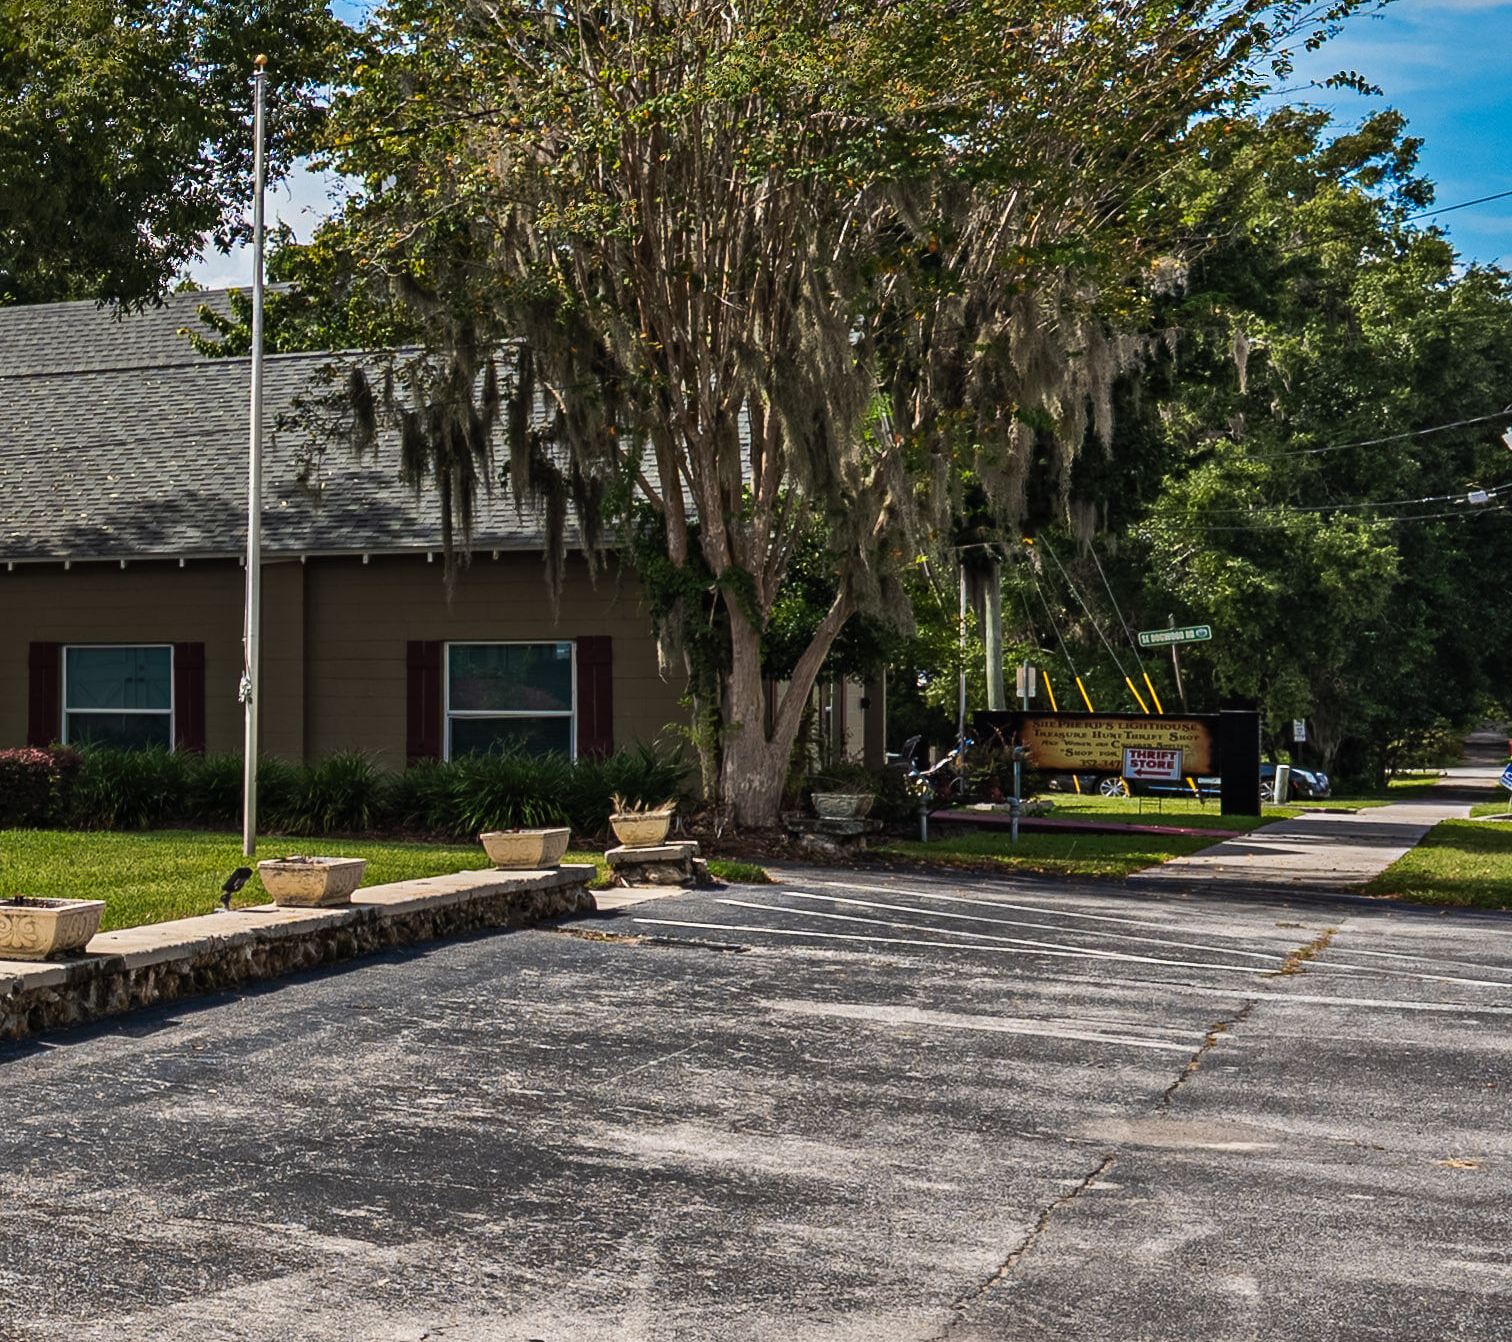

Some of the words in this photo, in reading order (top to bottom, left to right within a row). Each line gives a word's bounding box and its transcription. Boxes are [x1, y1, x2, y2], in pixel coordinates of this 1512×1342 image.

[1032, 720, 1114, 730] SHEPHERD'S
[1118, 722, 1197, 732] LIGHTHOUSE
[1032, 728, 1087, 739] TREASURE
[1092, 730, 1122, 739] HUNT
[1124, 730, 1163, 740] THRIFT
[1169, 732, 1200, 742] SHOP
[1129, 750, 1177, 760] THRIFT
[1130, 759, 1175, 769] STORE
